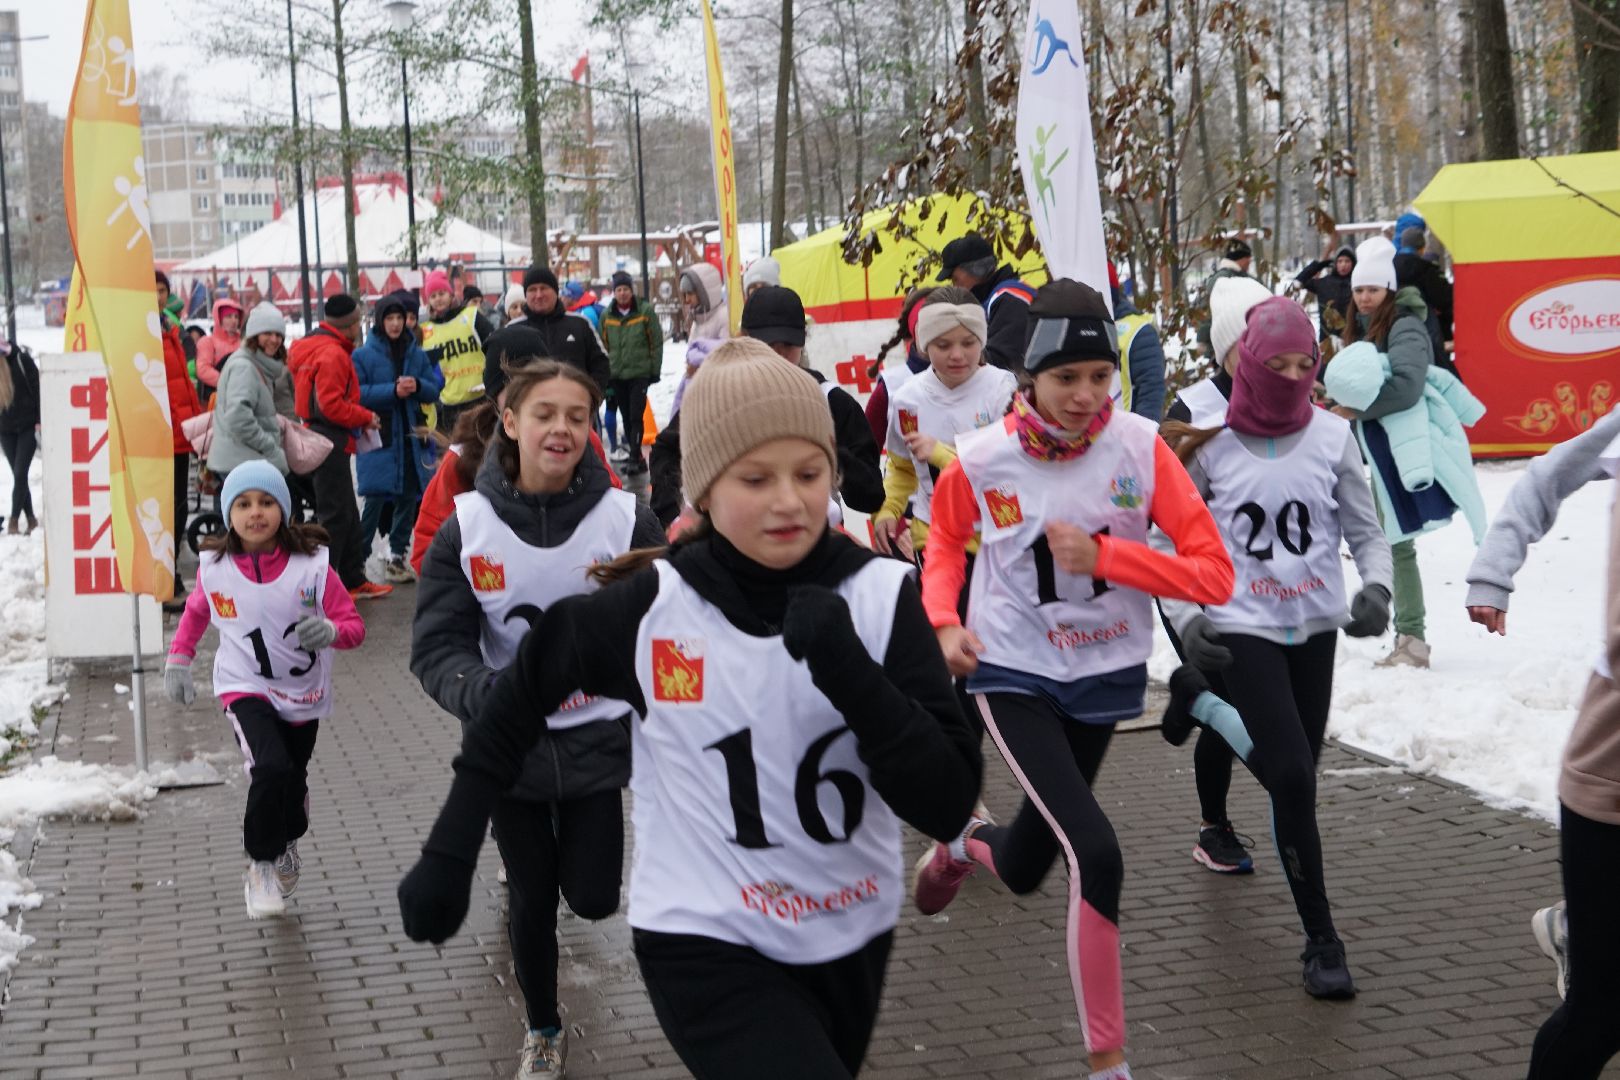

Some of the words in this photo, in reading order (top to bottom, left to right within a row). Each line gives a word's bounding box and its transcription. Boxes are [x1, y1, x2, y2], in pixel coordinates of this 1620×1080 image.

[437, 335, 479, 361] УДЬЯ
[1231, 500, 1313, 562] 20
[242, 621, 317, 680] 13
[702, 724, 867, 849] 16
